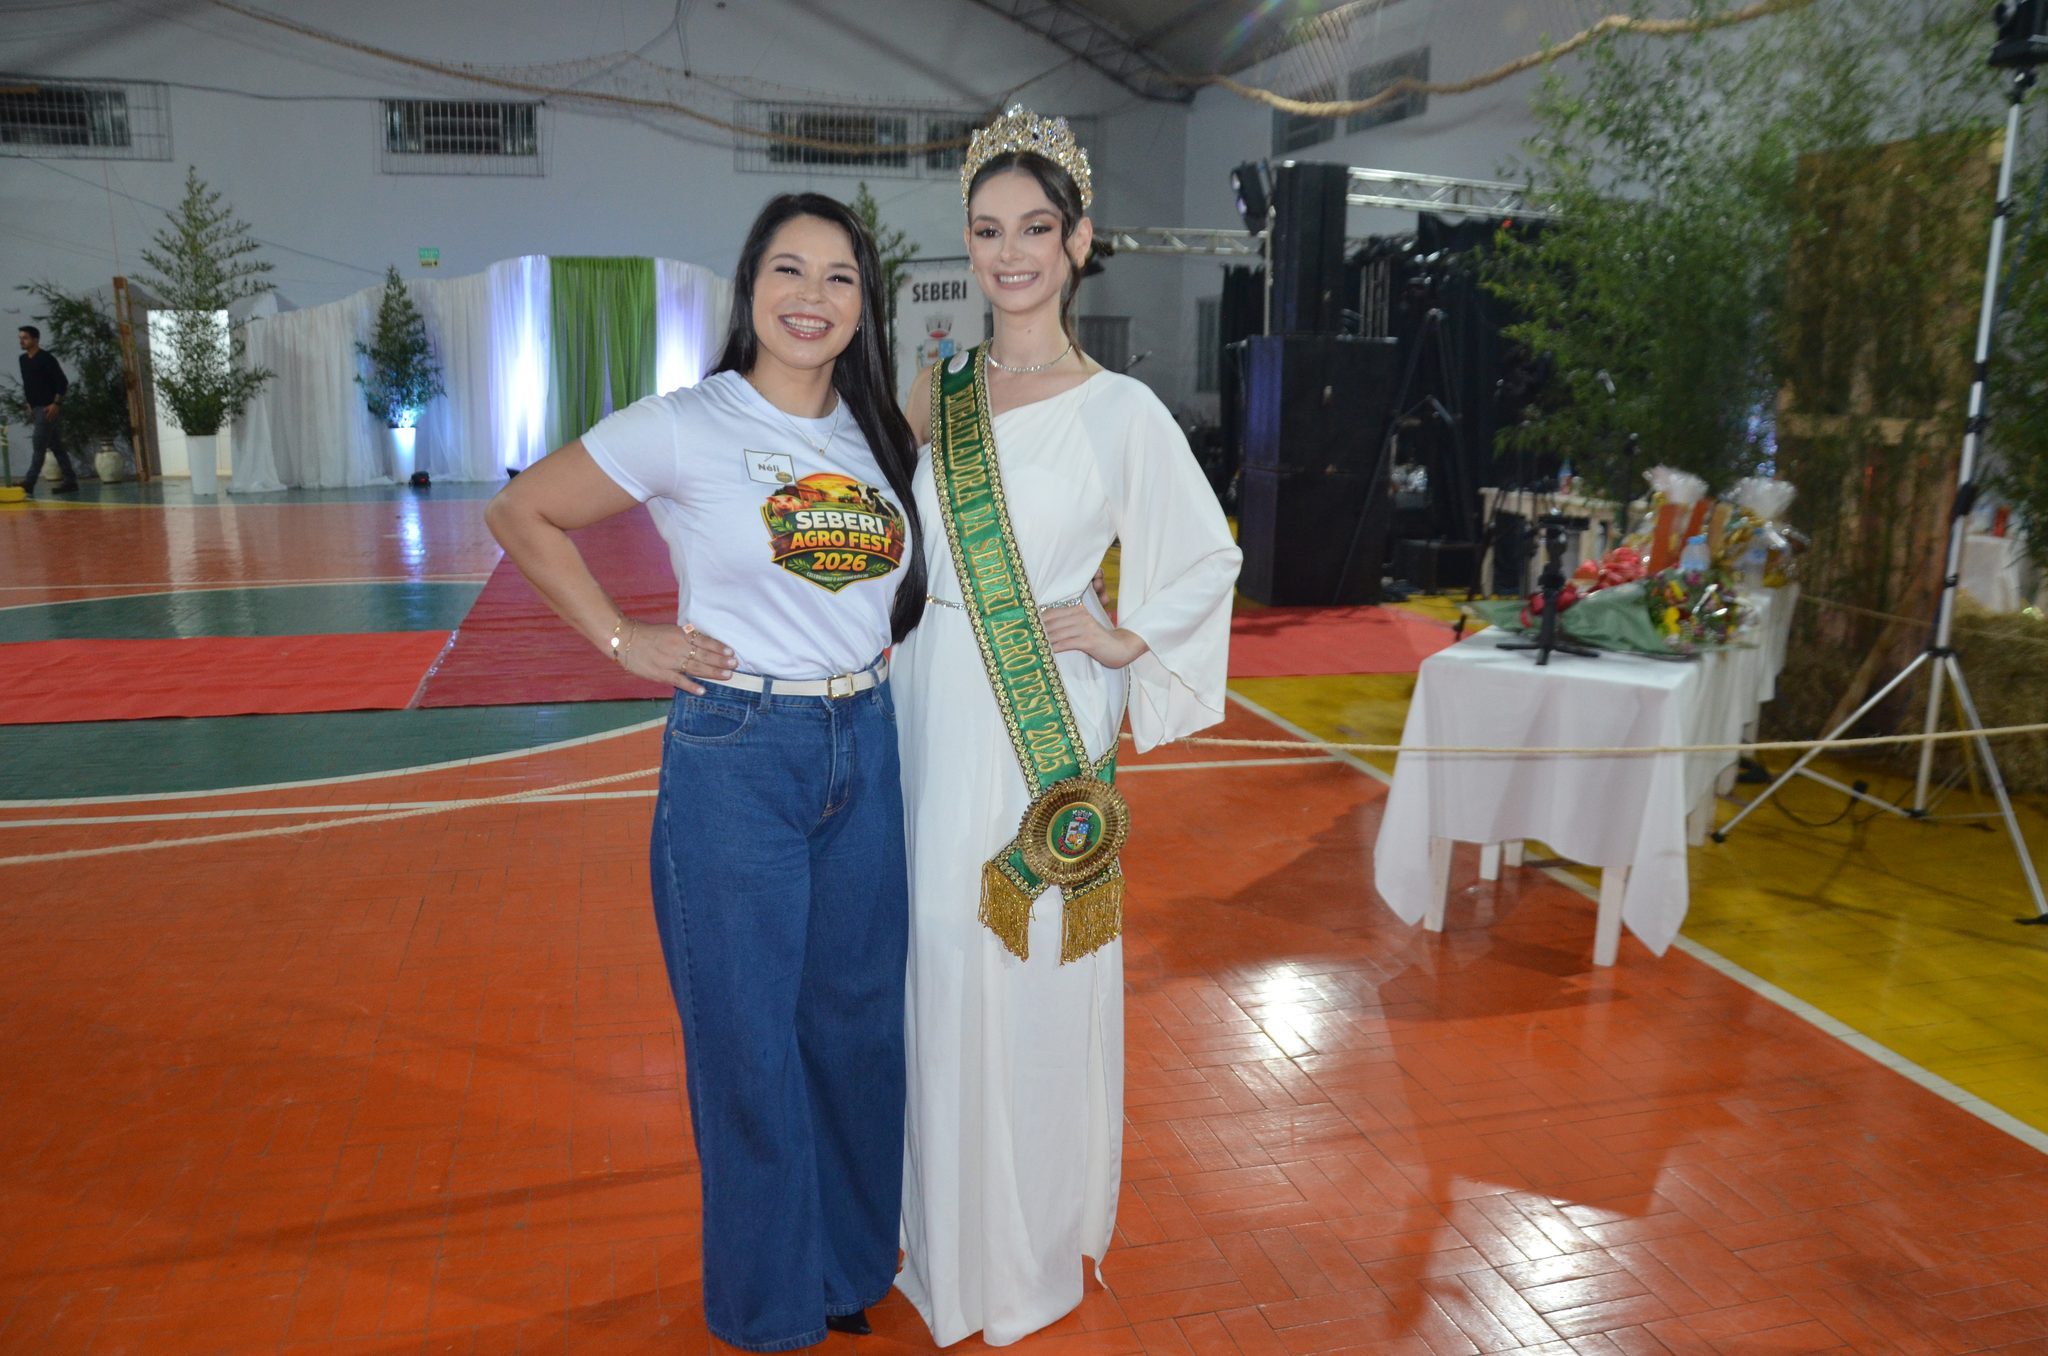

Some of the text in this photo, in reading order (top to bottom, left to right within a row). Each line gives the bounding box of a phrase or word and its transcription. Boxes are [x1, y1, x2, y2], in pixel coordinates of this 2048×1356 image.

[912, 282, 967, 303] SEBERI
[795, 511, 885, 535] SEBERI
[959, 503, 995, 537] DA
[790, 530, 892, 554] AGRO FEST
[812, 552, 868, 572] 2026
[967, 537, 1019, 616] SEBERI
[990, 617, 1037, 672] AGRO
[1008, 668, 1054, 721] FEST
[1026, 721, 1072, 773] 2025
